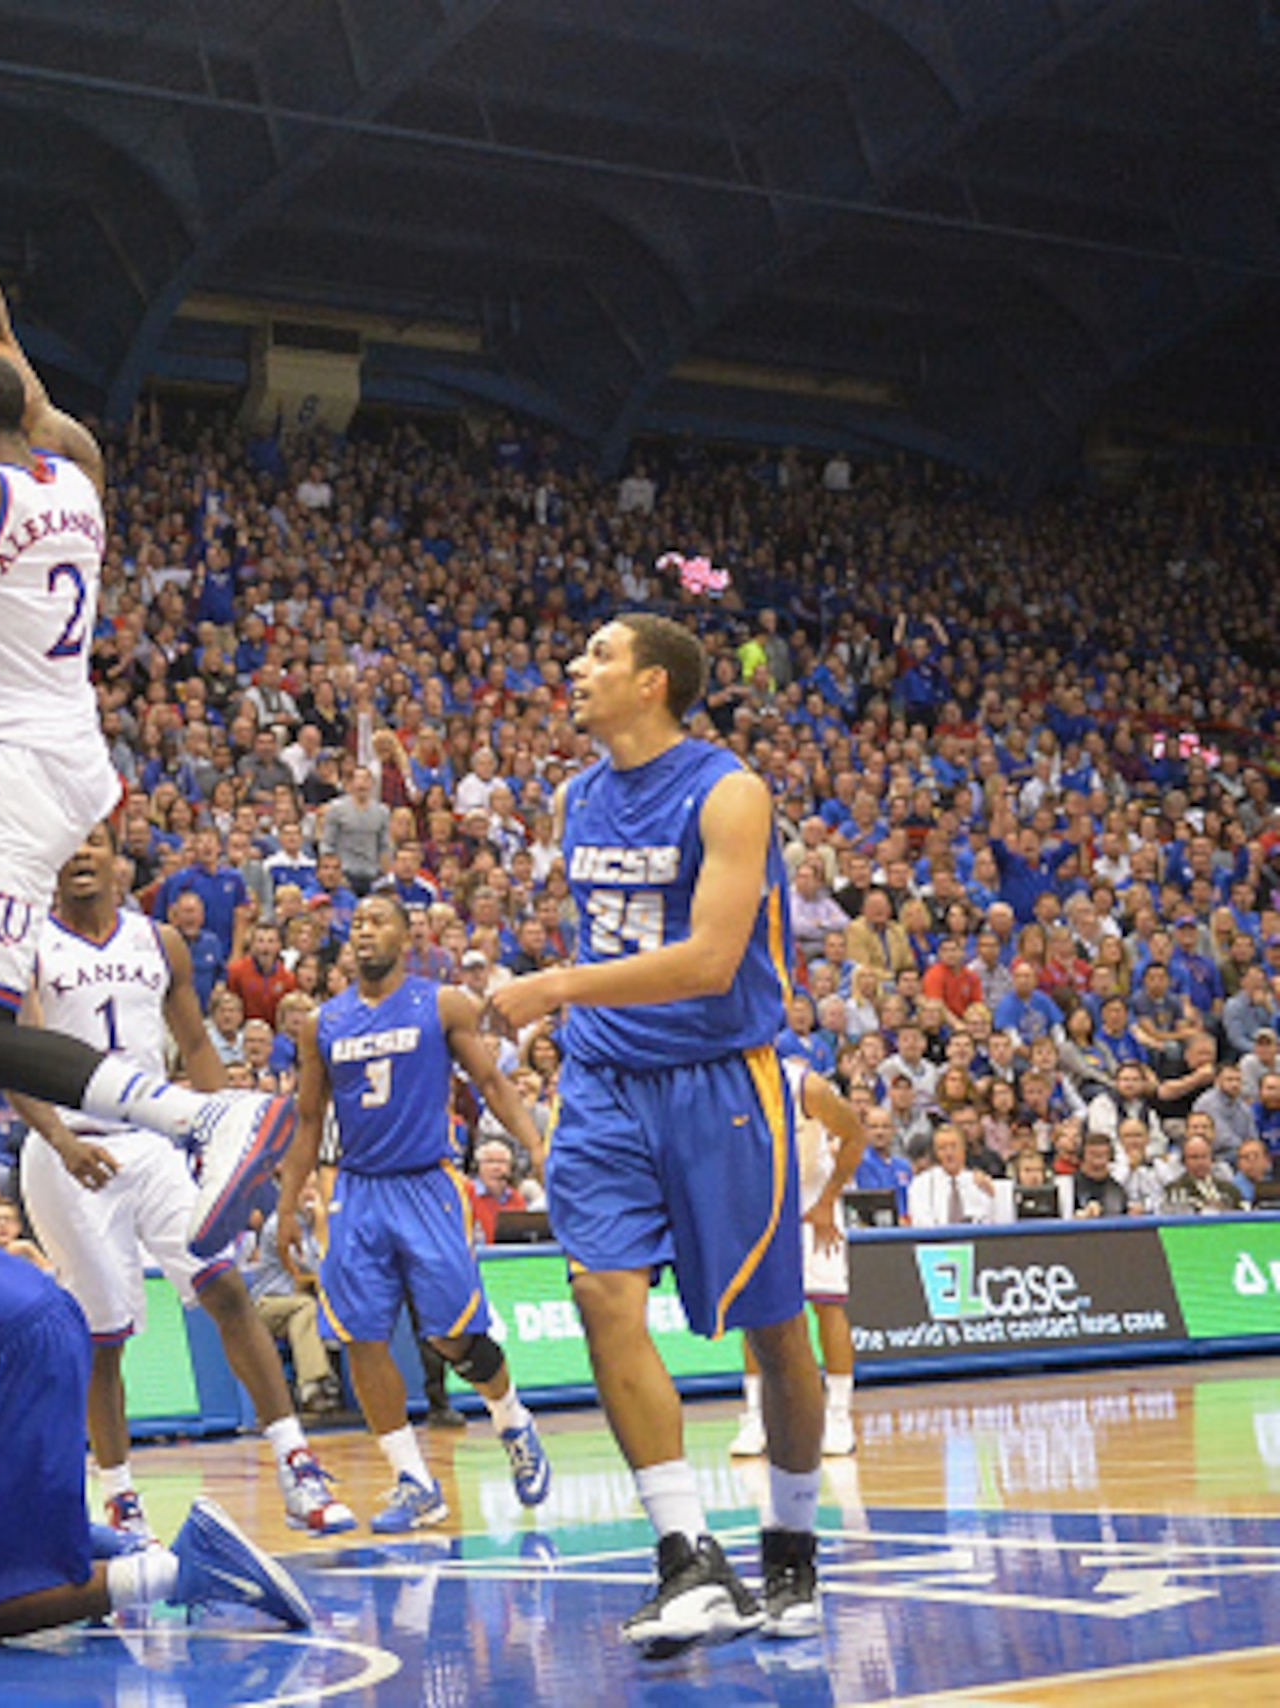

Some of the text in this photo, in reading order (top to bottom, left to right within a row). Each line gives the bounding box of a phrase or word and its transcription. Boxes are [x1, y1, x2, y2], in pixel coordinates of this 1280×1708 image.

[44, 562, 87, 660] 2
[569, 845, 680, 885] UCSB
[48, 964, 162, 999] KANSAS
[94, 994, 127, 1054] 1
[360, 1056, 393, 1109] 3
[962, 1319, 1008, 1343] best
[1079, 1312, 1121, 1335] lens
[1122, 1311, 1168, 1334] case
